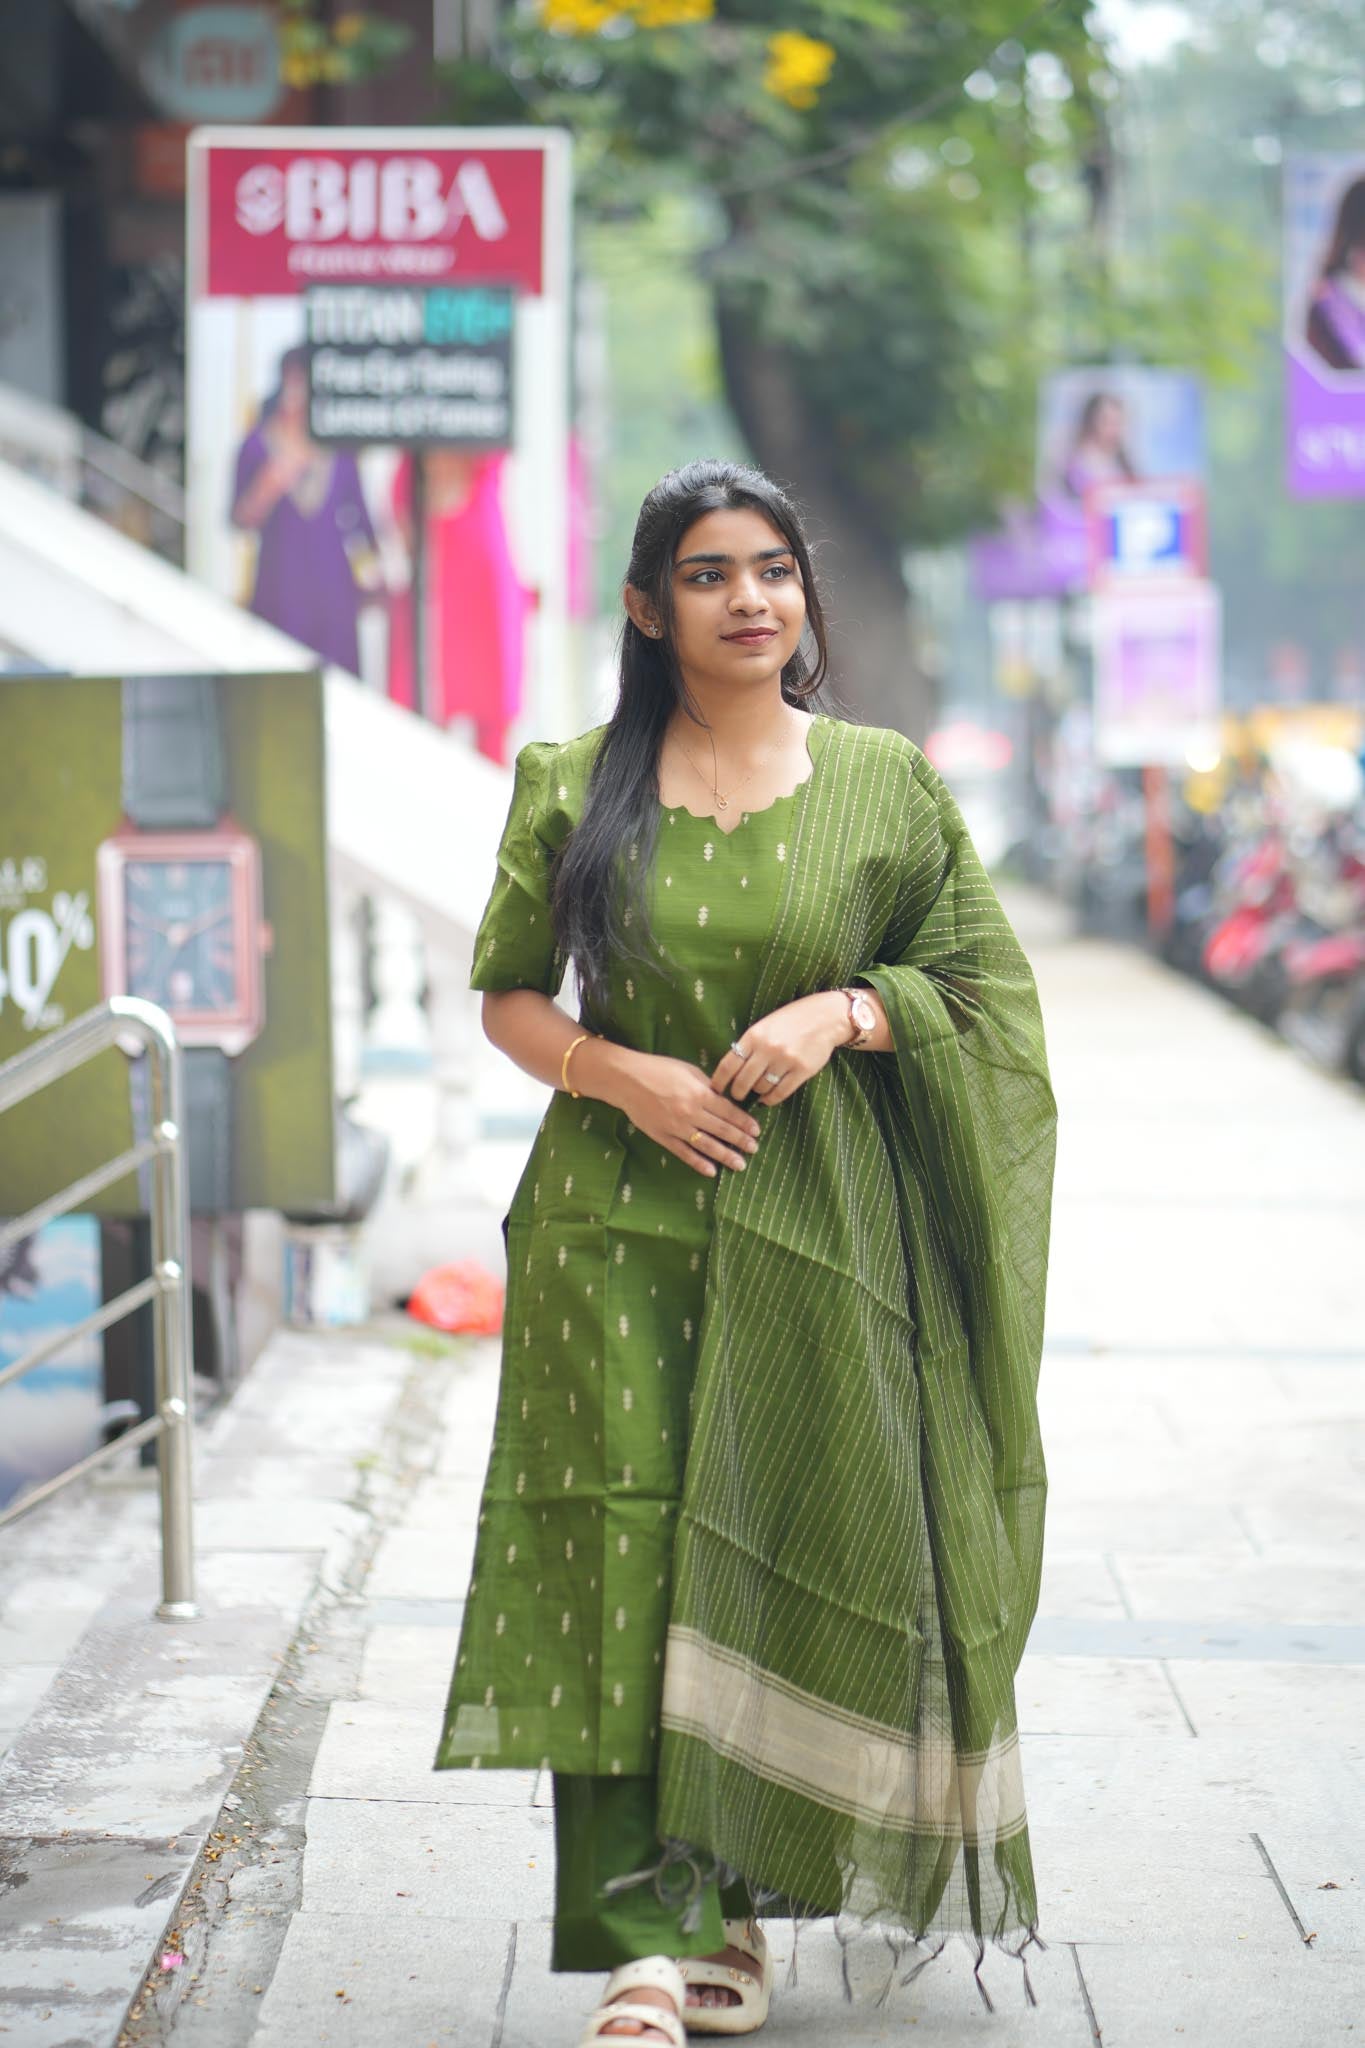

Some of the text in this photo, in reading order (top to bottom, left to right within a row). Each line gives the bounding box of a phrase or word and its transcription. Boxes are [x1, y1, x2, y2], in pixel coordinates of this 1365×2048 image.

[285, 157, 508, 241] BIBA
[310, 286, 424, 345] TITAN
[1116, 503, 1172, 568] P
[0, 886, 94, 1030] 0%
